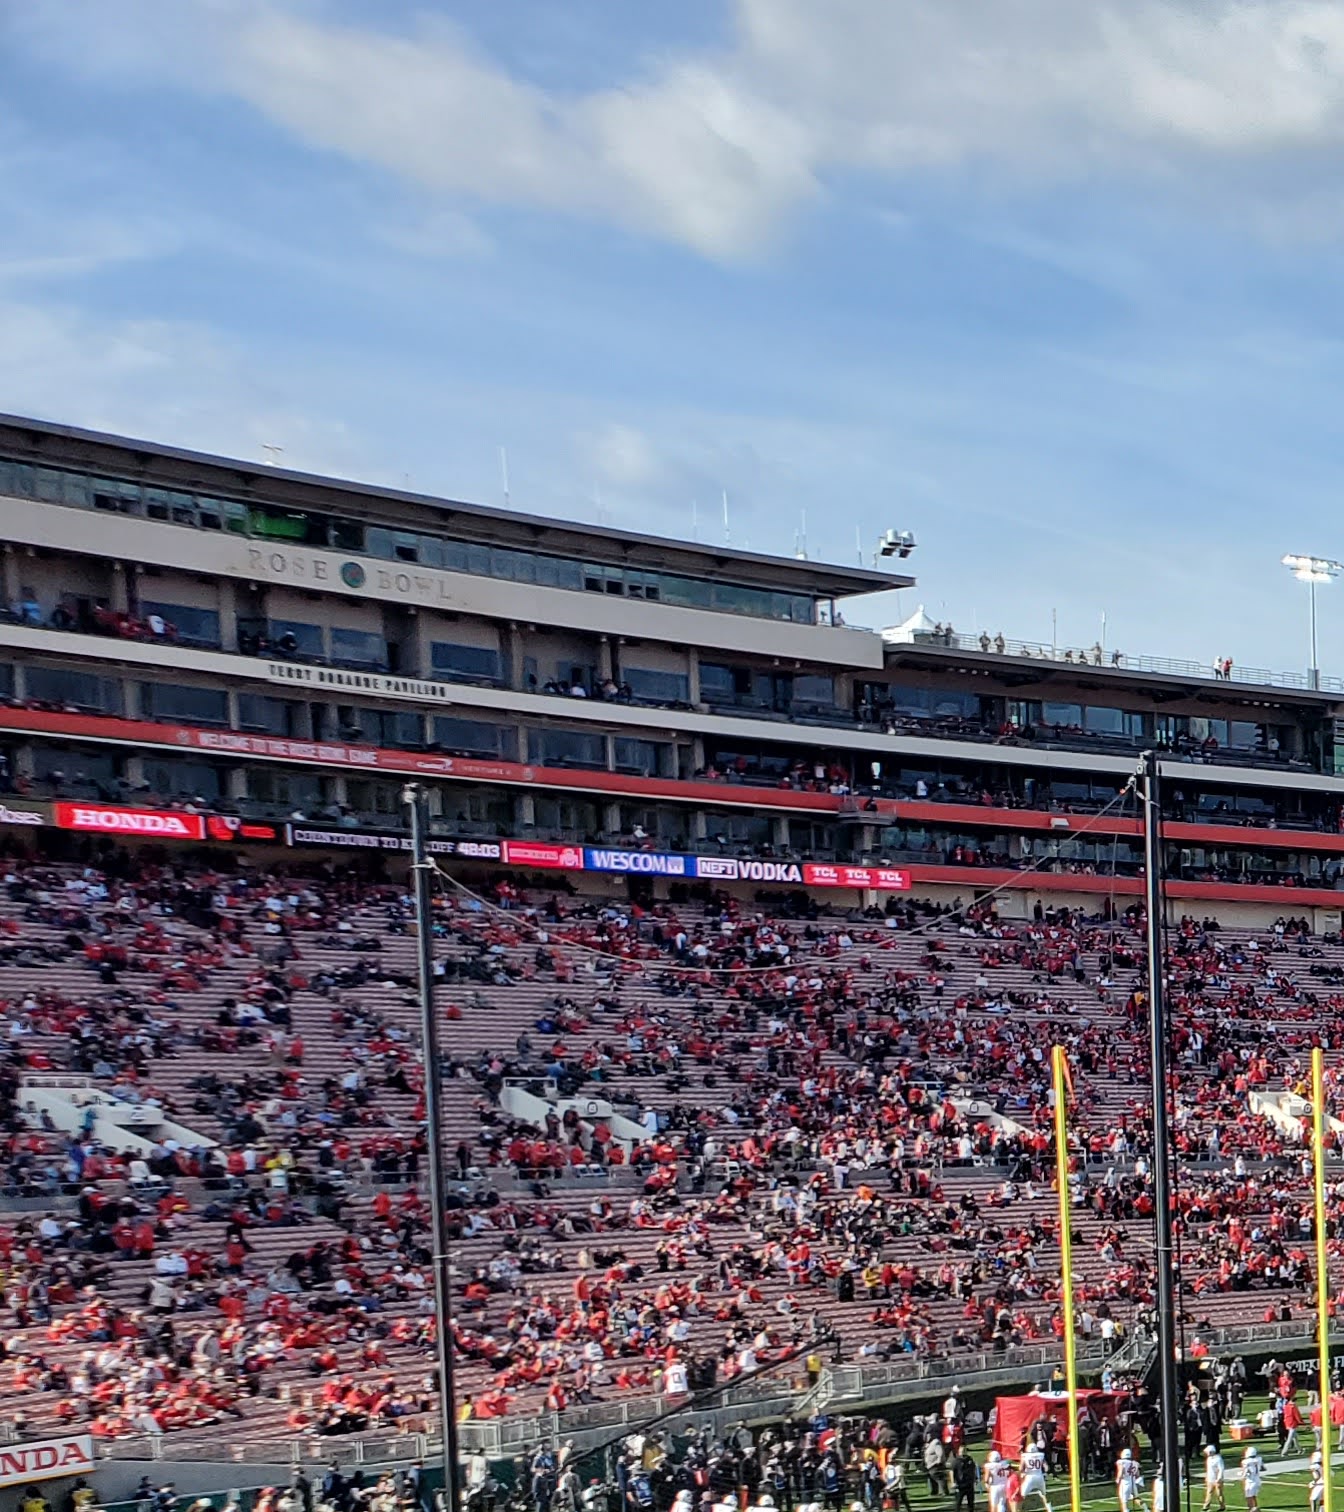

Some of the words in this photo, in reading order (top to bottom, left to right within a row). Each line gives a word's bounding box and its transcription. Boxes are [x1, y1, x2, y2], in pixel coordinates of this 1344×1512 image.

[249, 549, 328, 580] ROSE
[377, 570, 452, 600] BOWL
[72, 808, 191, 834] HONDA
[592, 850, 667, 873] WESCOM
[701, 861, 734, 874] NEFT
[738, 860, 802, 882] VODKA
[813, 867, 837, 878] TCL
[845, 869, 870, 880] TCL
[878, 871, 903, 882] TCL
[0, 1442, 91, 1477] NDA
[1028, 1459, 1041, 1470] 90
